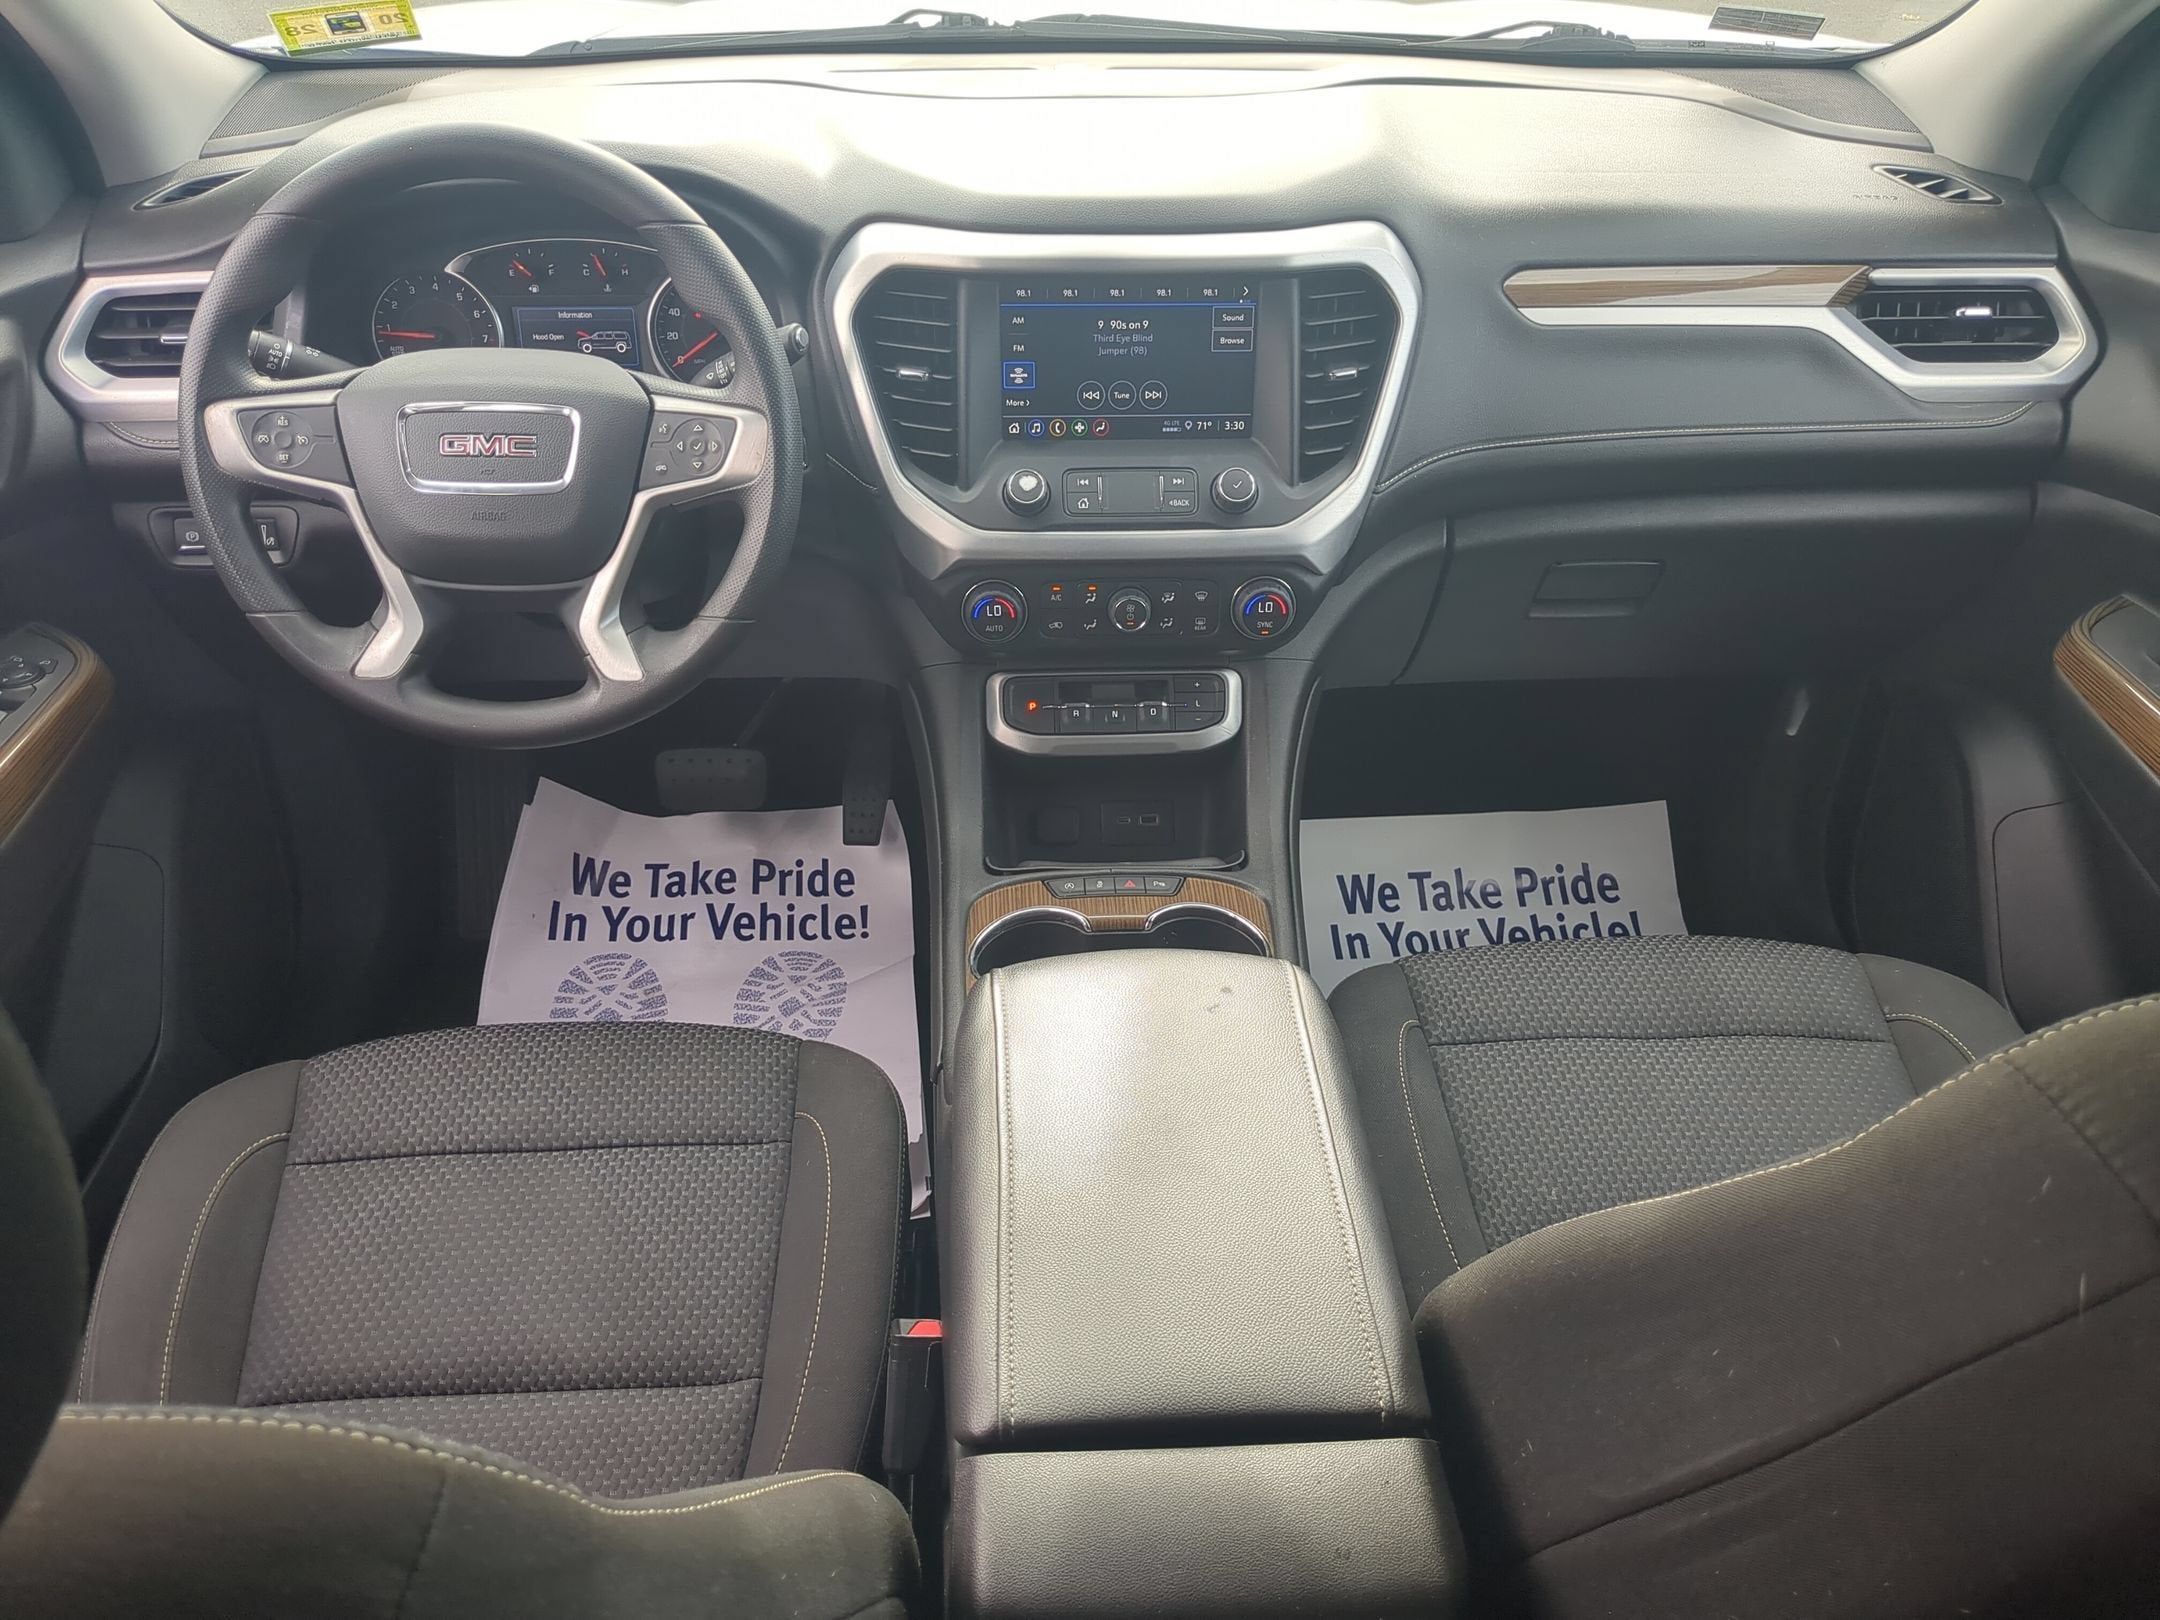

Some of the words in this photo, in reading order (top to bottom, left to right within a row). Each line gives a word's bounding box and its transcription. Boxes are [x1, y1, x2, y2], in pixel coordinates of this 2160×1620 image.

[509, 269, 515, 277] E
[409, 286, 415, 295] 3
[432, 282, 439, 291] 4
[456, 293, 463, 302] 5
[1016, 289, 1031, 297] 98.1
[1063, 289, 1078, 297] 98.1
[1110, 289, 1125, 297] 98.1
[1156, 289, 1171, 297] 98.1
[1203, 289, 1218, 297] 98.1
[391, 301, 398, 310] 2
[473, 310, 480, 319] 6
[558, 311, 593, 319] Information
[668, 307, 681, 317] 40
[1012, 316, 1024, 325] AM
[1222, 313, 1244, 322] Sound
[1097, 320, 1104, 329] 9
[1110, 319, 1127, 330] 90s
[1129, 321, 1141, 329] on
[1142, 319, 1149, 330] 9
[482, 334, 489, 343] 7
[549, 334, 565, 342] Open
[666, 331, 679, 340] 20
[1093, 333, 1113, 343] Third
[1116, 333, 1130, 345] Eye
[1132, 333, 1153, 343] Blind
[1220, 336, 1245, 345] Browse
[1013, 343, 1025, 352] FM
[1098, 346, 1127, 355] Jumper
[1130, 346, 1148, 356] (98)
[1113, 391, 1130, 400] Tune
[1006, 399, 1025, 407] More
[277, 418, 288, 426] RES
[1224, 421, 1245, 430] 3:30
[439, 433, 537, 458] GMC
[1173, 498, 1190, 507] BACK
[1051, 593, 1062, 601] A/C
[986, 604, 1002, 617] LO
[1258, 601, 1273, 613] LO
[985, 625, 1004, 633] AUTO
[1256, 621, 1273, 629] SYNC
[1029, 702, 1036, 711] P
[1073, 710, 1079, 718] R
[1111, 710, 1118, 718] N
[571, 851, 632, 899] We
[644, 860, 738, 898] Take
[751, 858, 856, 896] Pride
[1336, 873, 1401, 915] We
[1407, 867, 1502, 912] Take
[1513, 862, 1620, 908] Pride
[547, 900, 588, 942] In
[601, 904, 696, 943] Your
[705, 903, 871, 941] Vehicle!
[1330, 923, 1371, 961] In
[1377, 921, 1470, 957] Your
